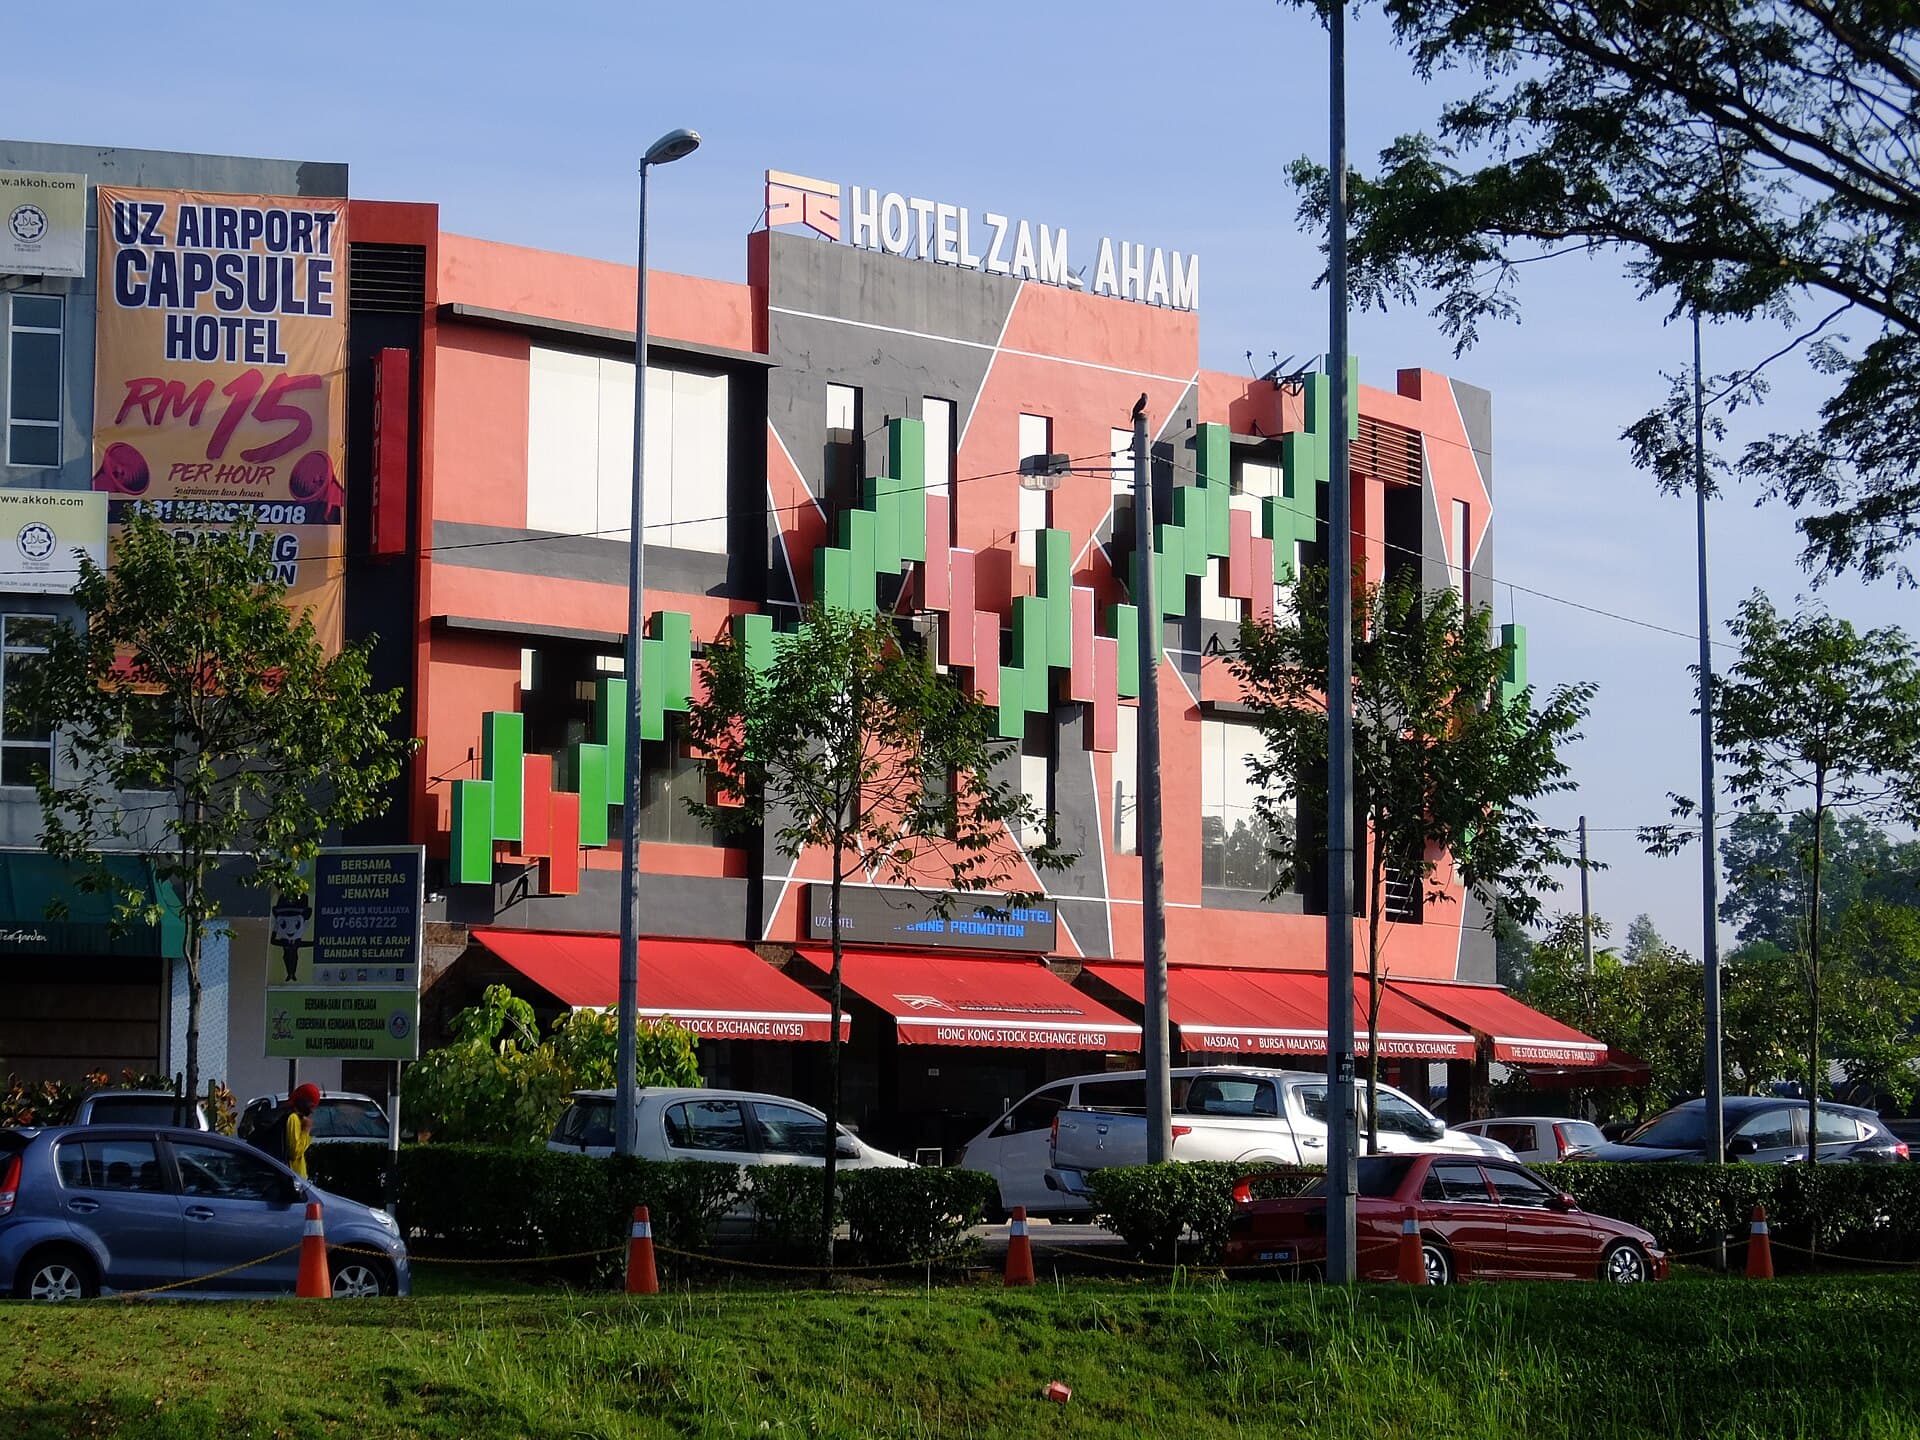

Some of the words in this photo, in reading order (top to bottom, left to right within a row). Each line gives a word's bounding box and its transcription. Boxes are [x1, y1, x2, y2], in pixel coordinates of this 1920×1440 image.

[113, 201, 165, 246] UZ
[176, 206, 336, 255] AIRPORT
[849, 185, 979, 268] HOTEL
[983, 212, 1068, 285] ZAM
[1094, 237, 1199, 310] AHAM
[114, 248, 333, 317] CAPSULE
[165, 314, 287, 364] HOTEL
[168, 463, 214, 482] PER
[215, 464, 276, 485] HOUR
[220, 487, 237, 497] two
[238, 487, 265, 498] hours
[257, 504, 306, 525] 2018
[341, 859, 392, 871] BERSAMA
[327, 873, 406, 885] MEMBANTERAS
[341, 888, 390, 899] JENAYAH
[332, 917, 398, 929] 07-6637222
[815, 916, 827, 928] UZ
[1012, 908, 1053, 923] HOTEL
[950, 920, 1025, 938] PROMOTION
[319, 935, 368, 946] KULAIJAYA
[370, 935, 383, 945] KE
[385, 935, 411, 945] ARAH
[323, 948, 359, 959] BANDAR
[362, 948, 405, 958] SELAMAT
[680, 1020, 714, 1034] STOCK
[716, 1020, 770, 1035] EXCHANGE
[772, 1023, 805, 1037] (NYSE)
[937, 1028, 966, 1041] HONG
[967, 1028, 995, 1042] KONG
[996, 1030, 1027, 1043] STOCK
[1029, 1031, 1077, 1044] EXCHANGE
[1078, 1033, 1107, 1047] (HKSE)
[1203, 1036, 1239, 1049] NASDAQ
[1258, 1037, 1285, 1050] BURSA
[1286, 1038, 1327, 1051] MALAYSIA
[1389, 1042, 1415, 1054] STOCK
[1416, 1043, 1457, 1055] EXCHANGE
[1511, 1046, 1521, 1057] THE
[1521, 1047, 1538, 1058] STOCK
[1538, 1048, 1563, 1060] EXCHANGE
[1563, 1049, 1571, 1060] OF
[1571, 1050, 1596, 1061] THAILAND
